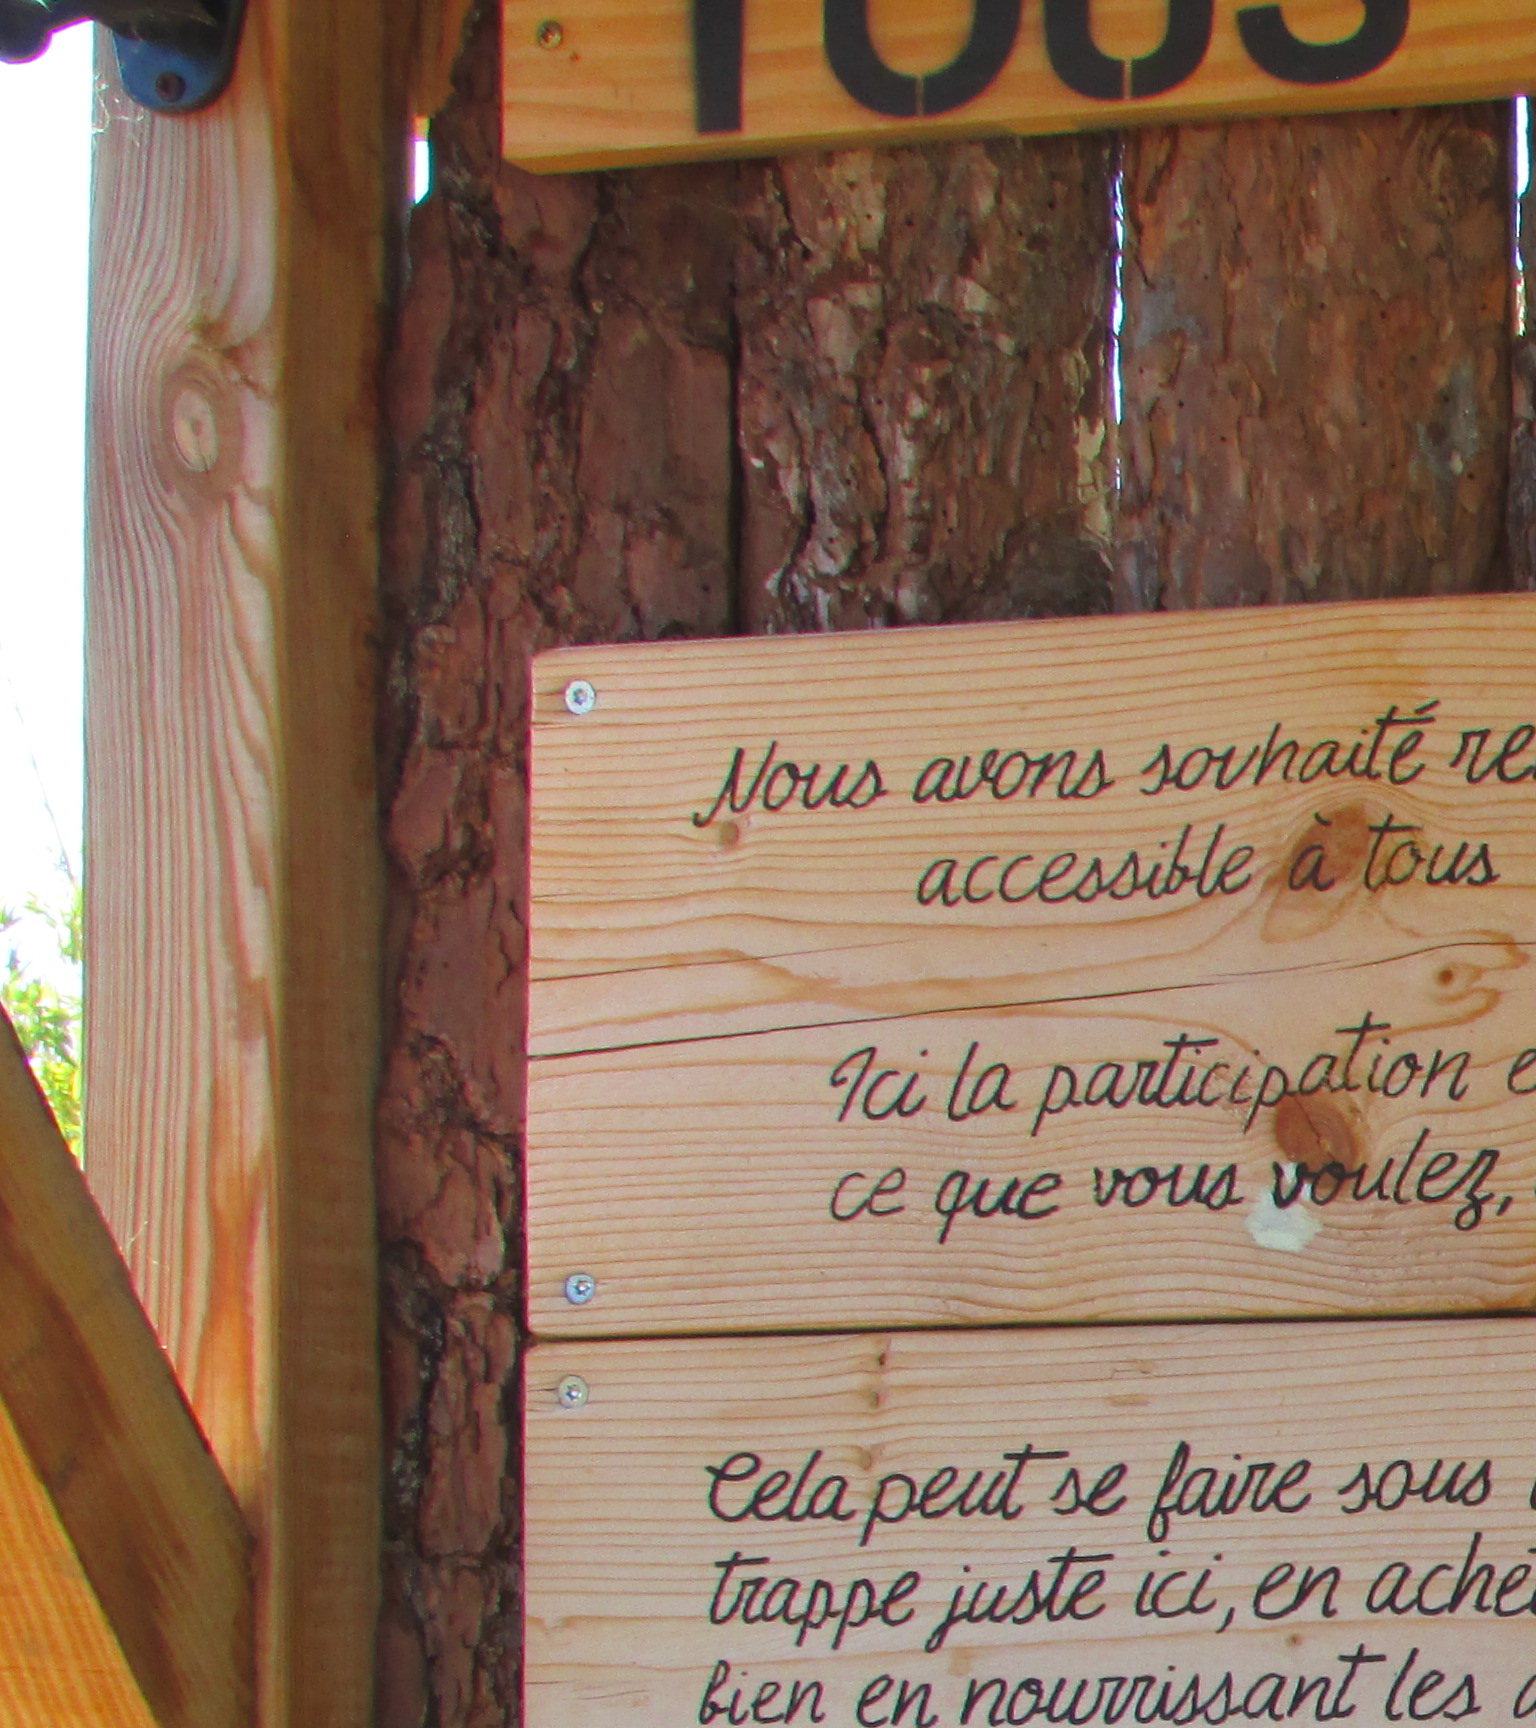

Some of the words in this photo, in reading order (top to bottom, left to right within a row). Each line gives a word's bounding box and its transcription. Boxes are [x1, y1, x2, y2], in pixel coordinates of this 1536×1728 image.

[693, 740, 887, 826] Nous
[912, 745, 1111, 805] avons
[1140, 700, 1440, 799] souhaité
[917, 823, 1252, 908] accessible
[1288, 812, 1337, 891] à
[1362, 812, 1500, 891] tous
[829, 1045, 929, 1124] Ici
[946, 1041, 1016, 1123] la
[1029, 1010, 1473, 1137] participation
[830, 1166, 905, 1223] ce
[934, 1167, 1063, 1244] que
[1093, 1160, 1245, 1210] vous
[1271, 1128, 1513, 1232] voulez,
[704, 1449, 856, 1526] Cela
[859, 1443, 1068, 1547] peut
[1052, 1464, 1128, 1519] se
[1147, 1440, 1312, 1543] faire
[1339, 1452, 1493, 1514] sous
[708, 1551, 921, 1650] trappe
[924, 1546, 1115, 1654] juste
[1135, 1551, 1236, 1634] ici,
[1253, 1561, 1340, 1620] en
[697, 1660, 827, 1728] bien
[960, 1642, 1386, 1728] nourrissant
[1384, 1647, 1482, 1724] les
